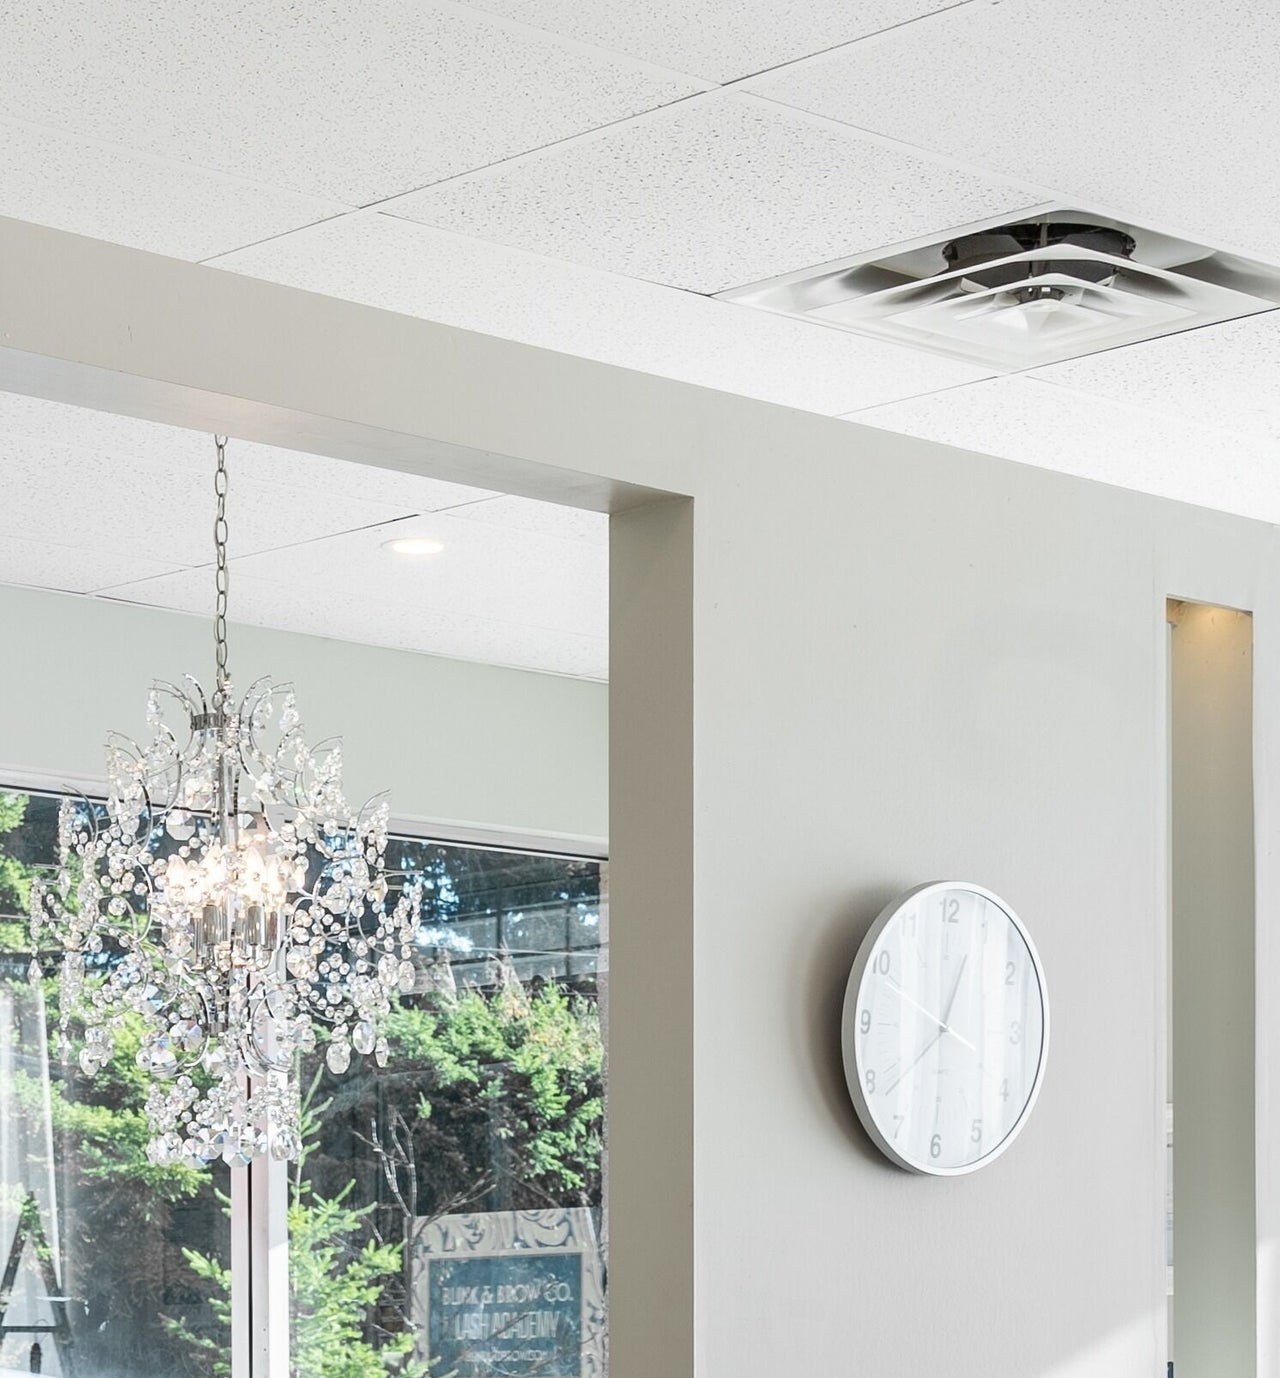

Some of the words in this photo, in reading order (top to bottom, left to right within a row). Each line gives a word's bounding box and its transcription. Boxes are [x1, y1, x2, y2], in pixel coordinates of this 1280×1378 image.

[939, 898, 960, 923] 12
[900, 913, 917, 937] 11
[872, 950, 891, 975] 10
[1004, 961, 1016, 986] 2
[860, 1009, 871, 1035] 9
[1009, 1021, 1020, 1045] 3
[865, 1069, 876, 1094] 8
[999, 1078, 1009, 1102] 4
[892, 1115, 905, 1139] 7
[970, 1119, 982, 1143] 5
[930, 1133, 942, 1158] 6
[442, 1286, 479, 1305] BLINK
[482, 1285, 493, 1304] &
[497, 1282, 539, 1304] BROW
[543, 1281, 574, 1303] CO.
[455, 1312, 488, 1340] LASH
[492, 1310, 561, 1340] ACADEMY
